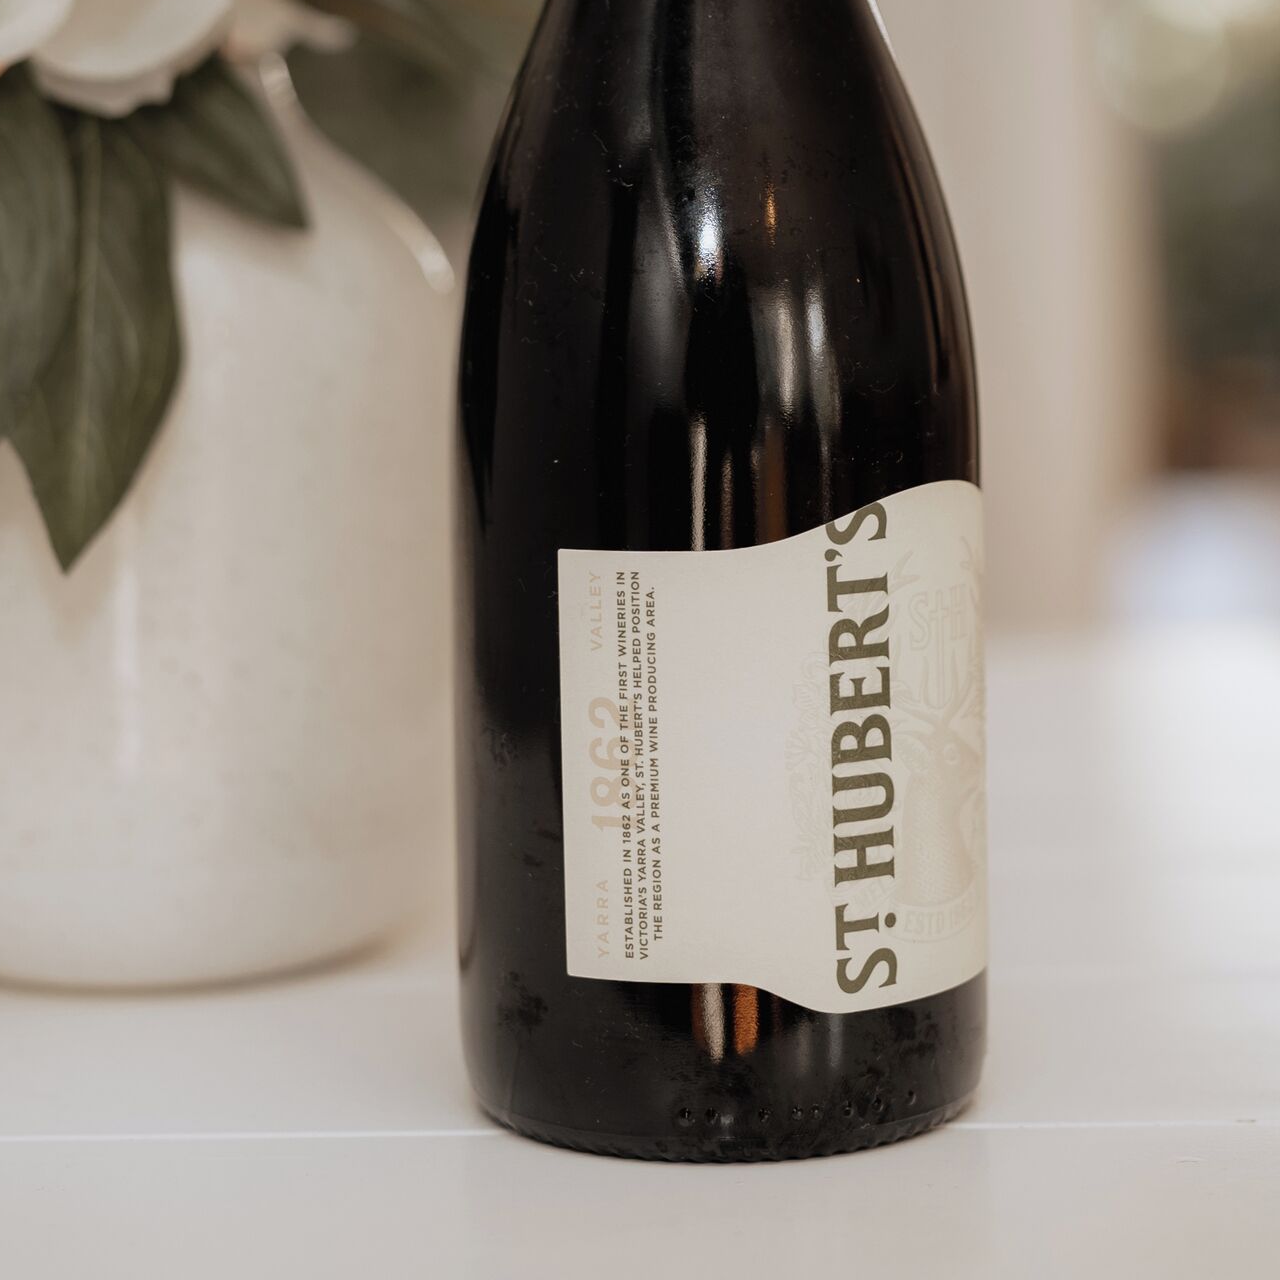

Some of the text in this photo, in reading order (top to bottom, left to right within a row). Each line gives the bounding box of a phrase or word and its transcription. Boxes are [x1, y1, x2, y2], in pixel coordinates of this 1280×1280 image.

[588, 569, 639, 958] YARRA 1862 VALLEY
[616, 572, 634, 958] ESTABLISHED IN 1862 AS ONE OF THE FIRST WINERIES IN
[630, 572, 648, 960] VICTORIA'S YARRA VALLEY, ST. HUBERT'S HELPED POSITION
[646, 587, 662, 941] THE REGION AS A PREMIUM WINE PRODUCING AREA.
[824, 502, 896, 888] HUBERT'S
